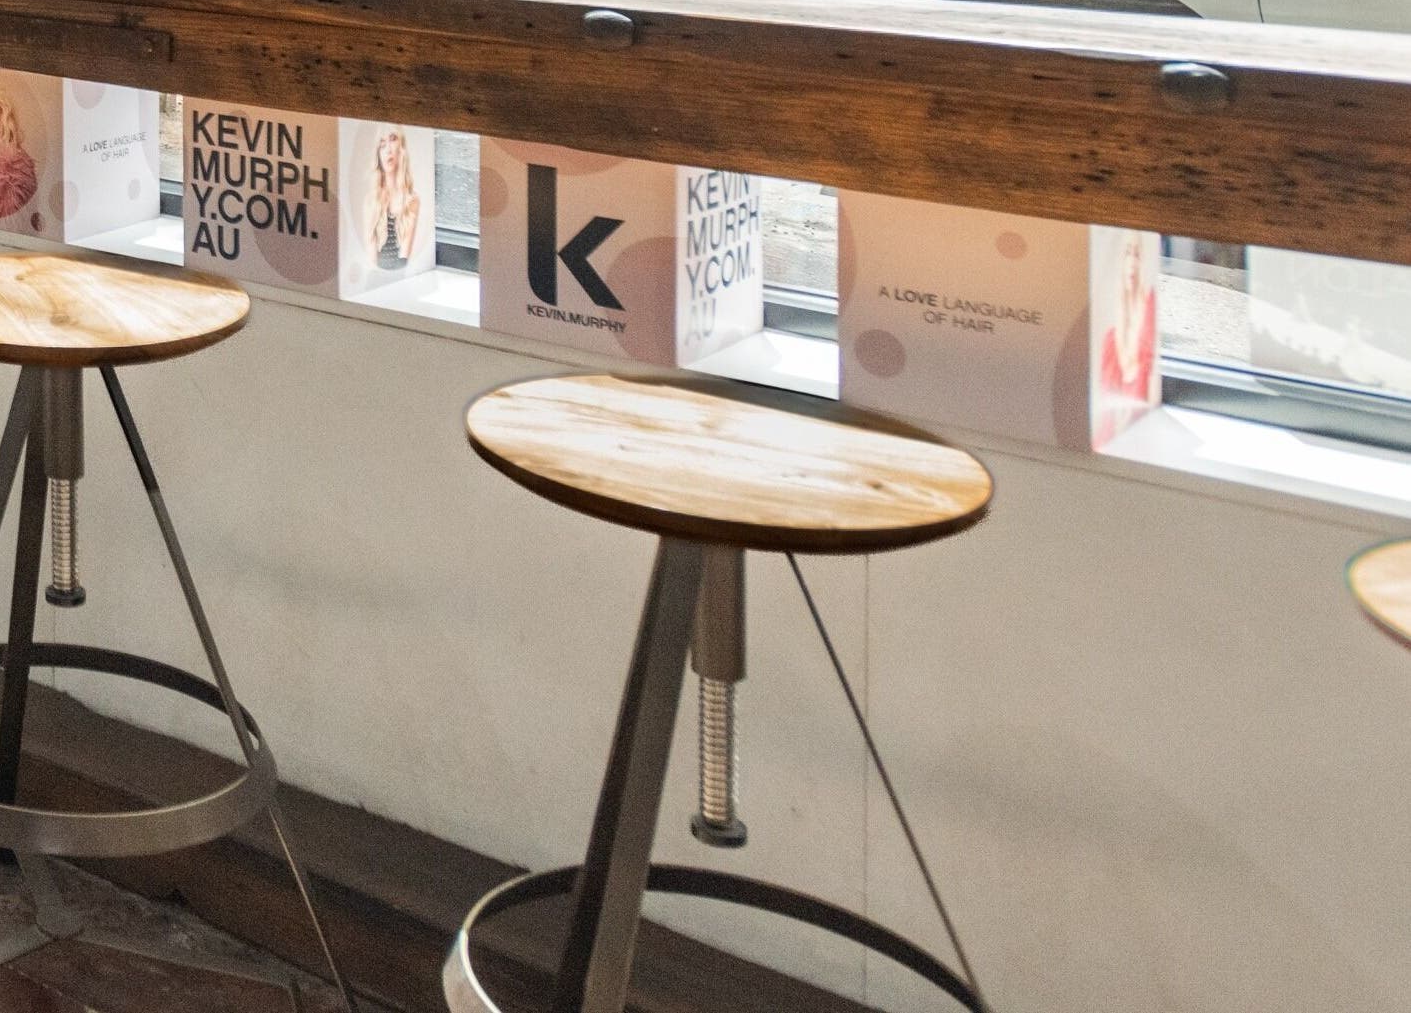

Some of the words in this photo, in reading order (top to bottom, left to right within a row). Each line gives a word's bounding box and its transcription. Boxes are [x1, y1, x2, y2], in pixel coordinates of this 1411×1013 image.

[89, 140, 108, 152] LOVE
[192, 110, 303, 160] KEVIN
[192, 147, 329, 203] MURPH
[687, 169, 751, 215] KEVIN
[191, 183, 319, 240] Y.COM.
[687, 195, 760, 259] MURPH
[192, 221, 240, 261] AU
[686, 241, 756, 301] Y.COM.
[527, 303, 627, 333] KEVIN.MURPHY
[878, 286, 890, 299] A
[894, 287, 938, 307] LOVE
[943, 296, 1044, 326] LANGUAGE
[923, 310, 947, 324] OF
[951, 315, 995, 333] HAIR
